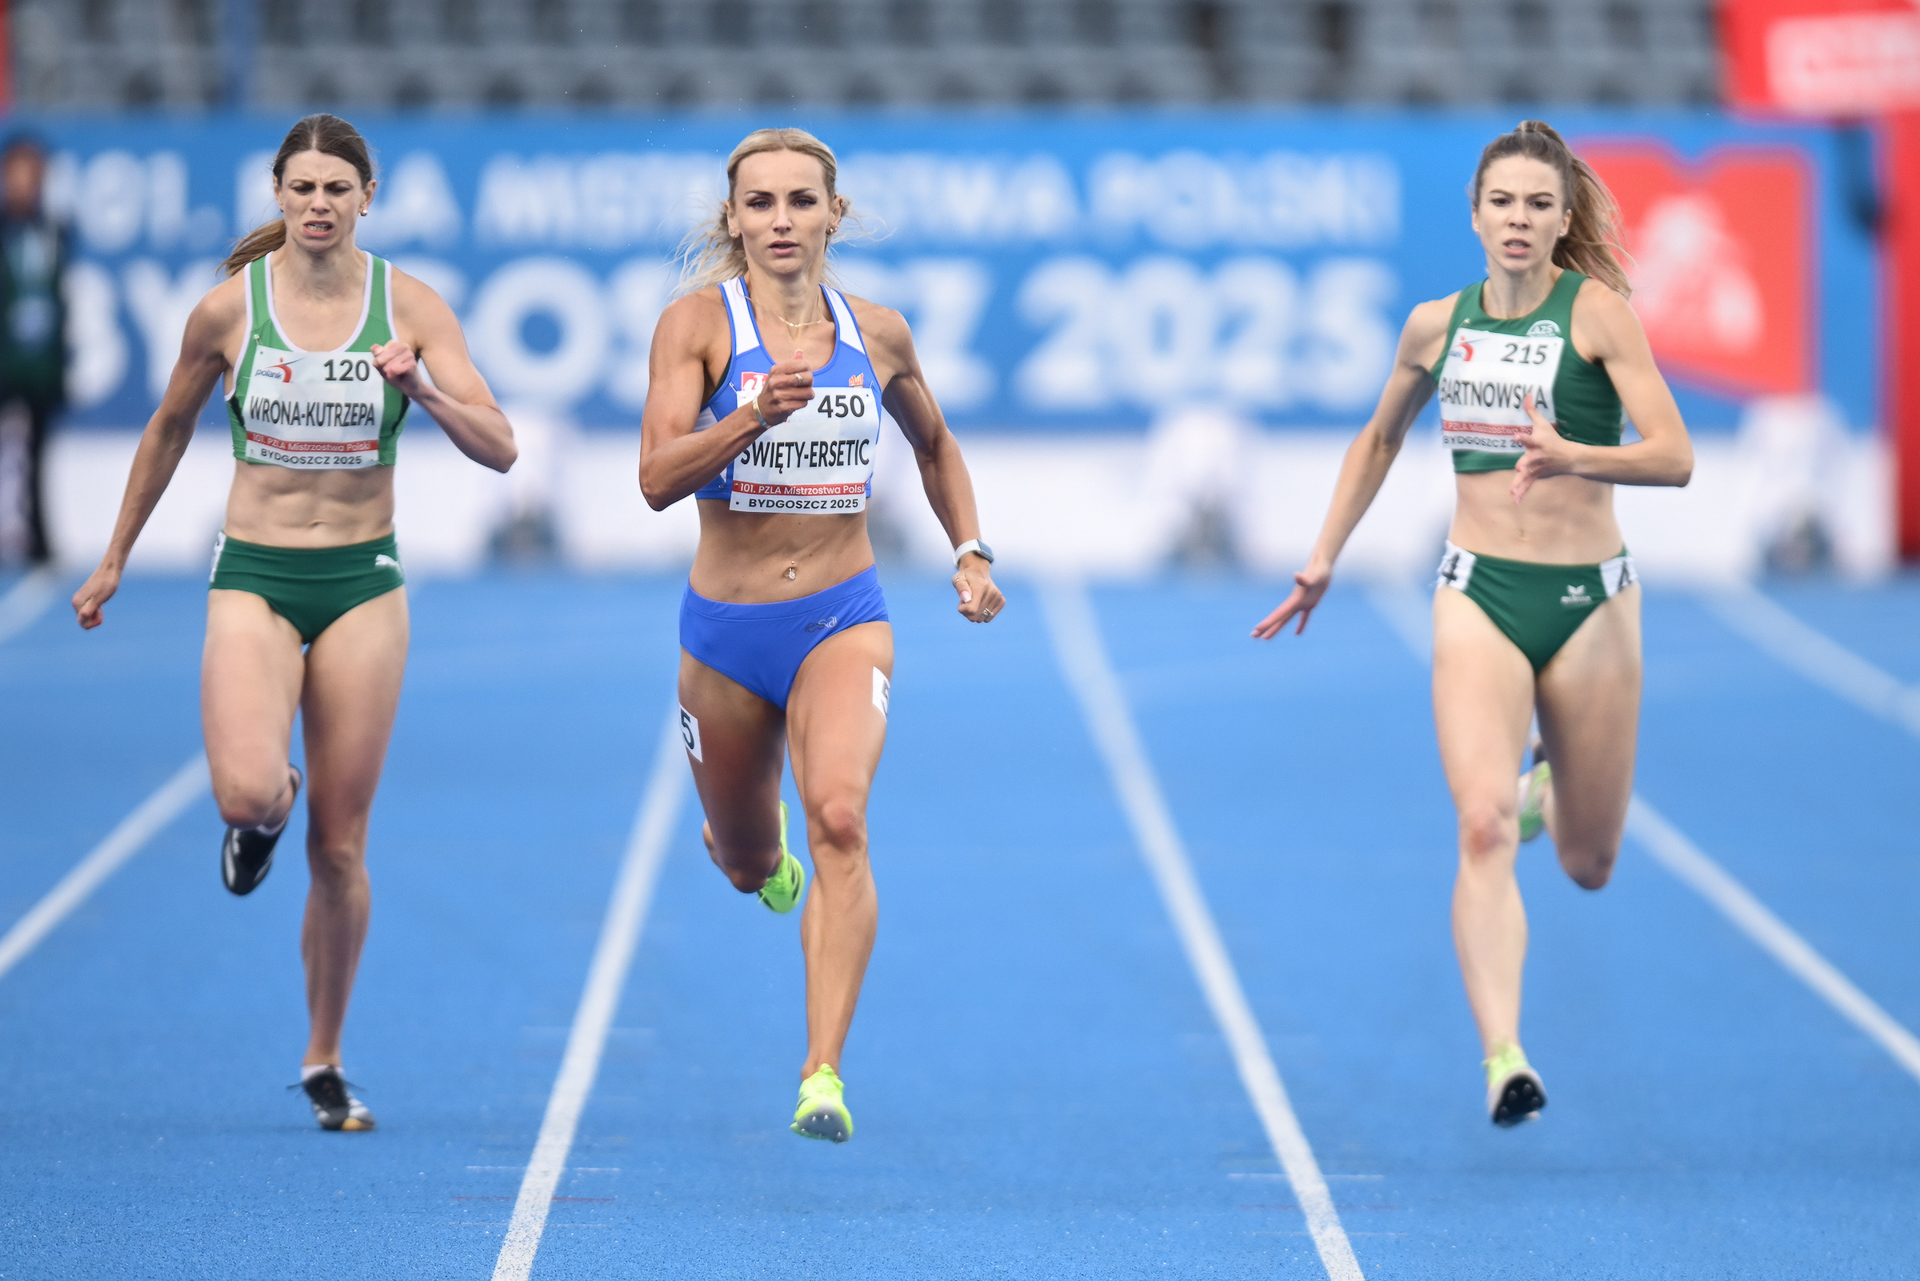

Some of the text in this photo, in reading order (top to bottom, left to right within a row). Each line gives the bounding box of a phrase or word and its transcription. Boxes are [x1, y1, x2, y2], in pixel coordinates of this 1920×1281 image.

[1014, 254, 1399, 410] 2025
[1500, 342, 1548, 365] 215
[323, 359, 370, 381] 120
[249, 396, 375, 427] WRONA-KUTRZEPA
[817, 395, 865, 418] 450
[252, 433, 371, 452] 101. PZLA Mistrzostwa Polski
[261, 448, 362, 465] BYDGOSZCZ 2025
[740, 483, 866, 496] 101. PZLA Mistrzostwa Polsk
[749, 498, 859, 509] BYDGOSZCZ 2025
[1442, 552, 1460, 585] 4
[681, 709, 695, 750] 5
